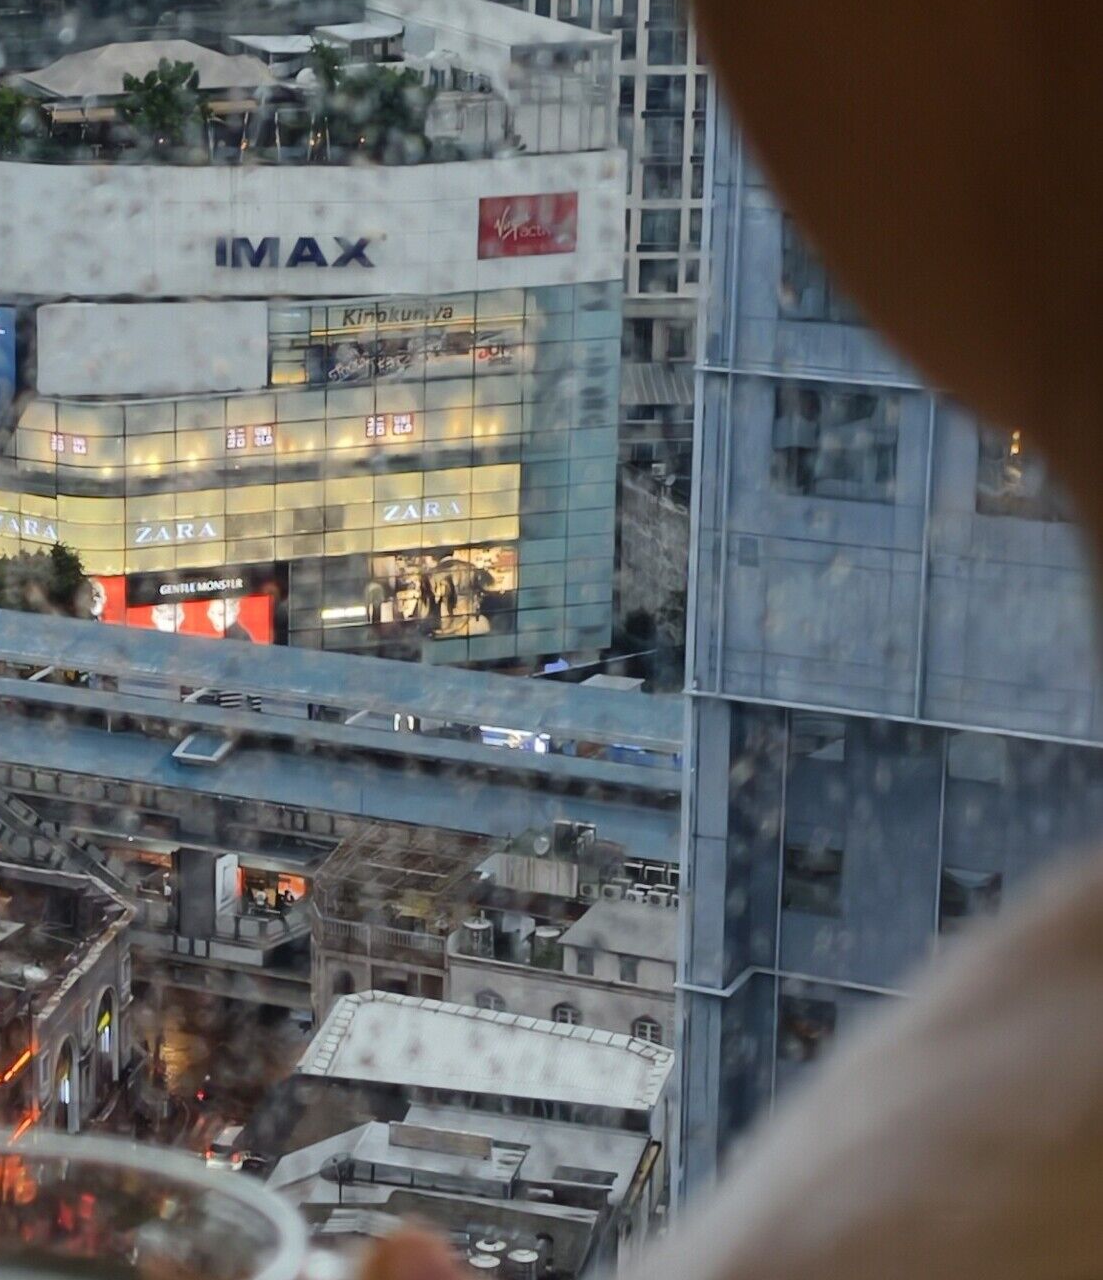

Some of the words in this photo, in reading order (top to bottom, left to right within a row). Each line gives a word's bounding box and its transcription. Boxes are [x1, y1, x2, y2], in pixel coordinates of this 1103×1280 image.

[215, 235, 376, 268] IMAX
[383, 501, 461, 521] ZARA
[135, 522, 217, 543] ZARA
[159, 582, 196, 595] GENTLE
[197, 578, 243, 592] MONSTER
